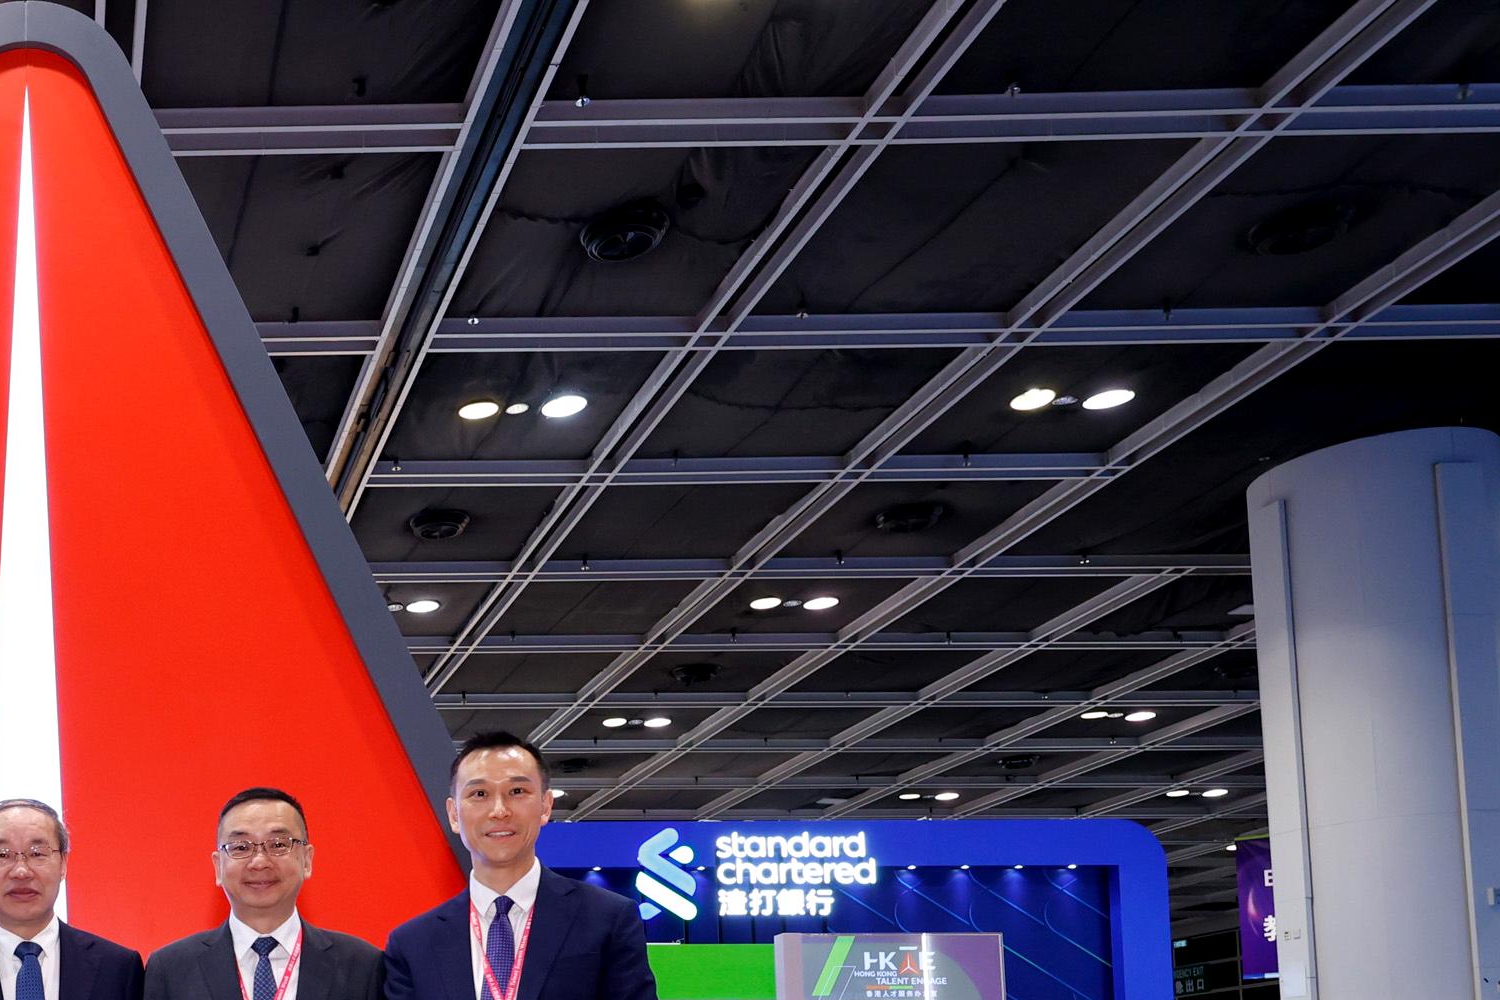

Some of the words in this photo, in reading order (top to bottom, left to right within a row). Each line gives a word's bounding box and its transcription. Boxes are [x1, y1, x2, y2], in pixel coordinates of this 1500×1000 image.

[715, 831, 867, 859] standard
[716, 857, 878, 885] chartered
[876, 977, 909, 985] TALENT
[911, 977, 948, 985] ENAGE
